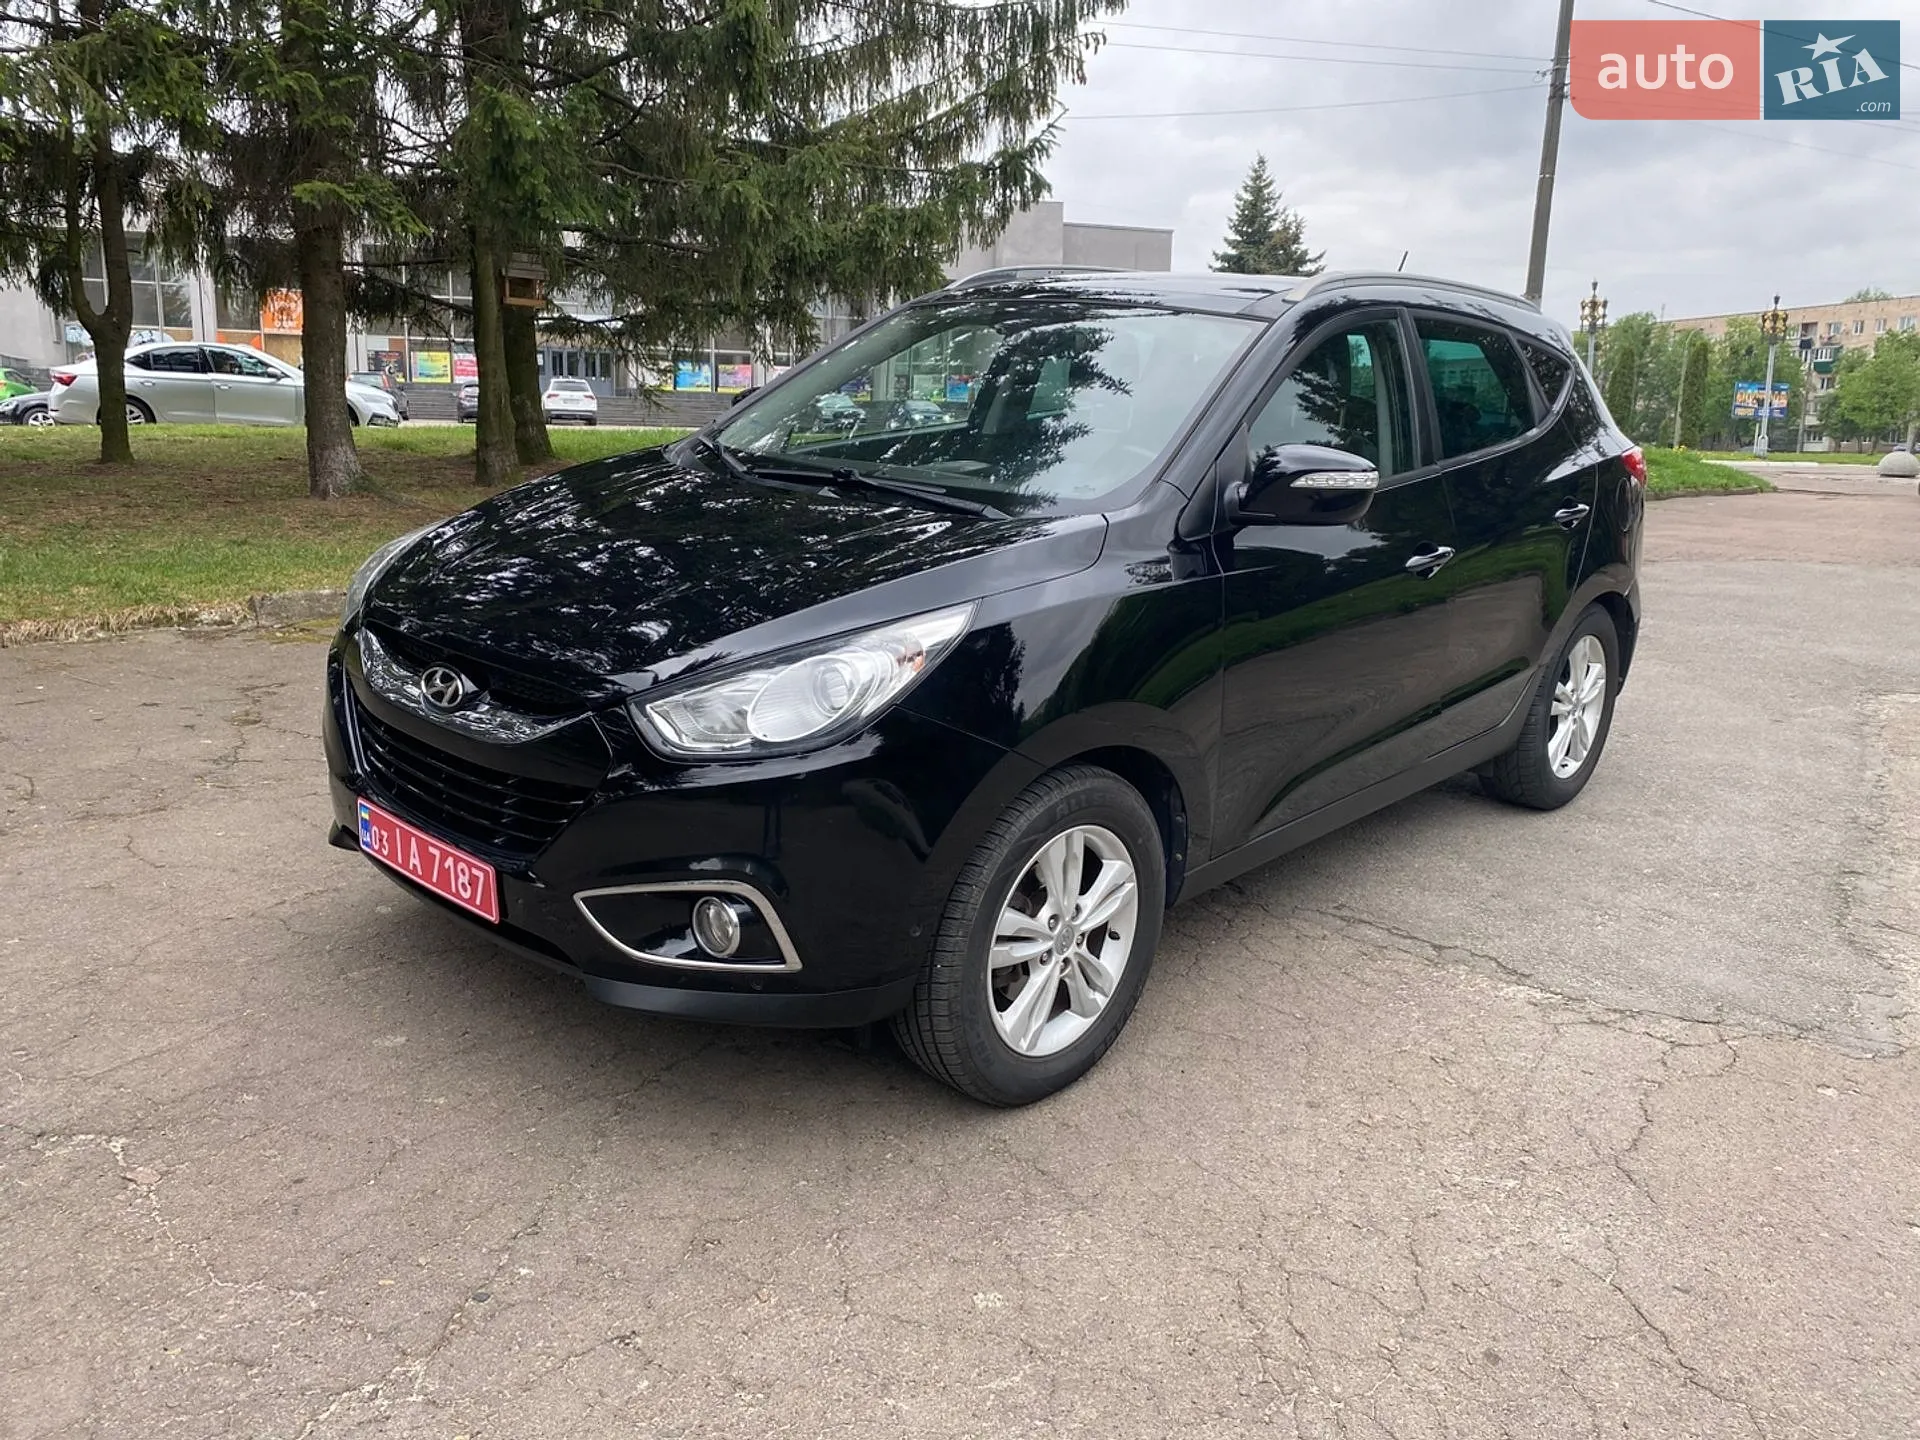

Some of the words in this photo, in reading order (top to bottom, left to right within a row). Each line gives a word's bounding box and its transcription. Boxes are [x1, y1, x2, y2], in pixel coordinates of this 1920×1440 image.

[371, 825, 389, 857] 03
[396, 828, 423, 876] IA
[428, 846, 485, 906] 7187
